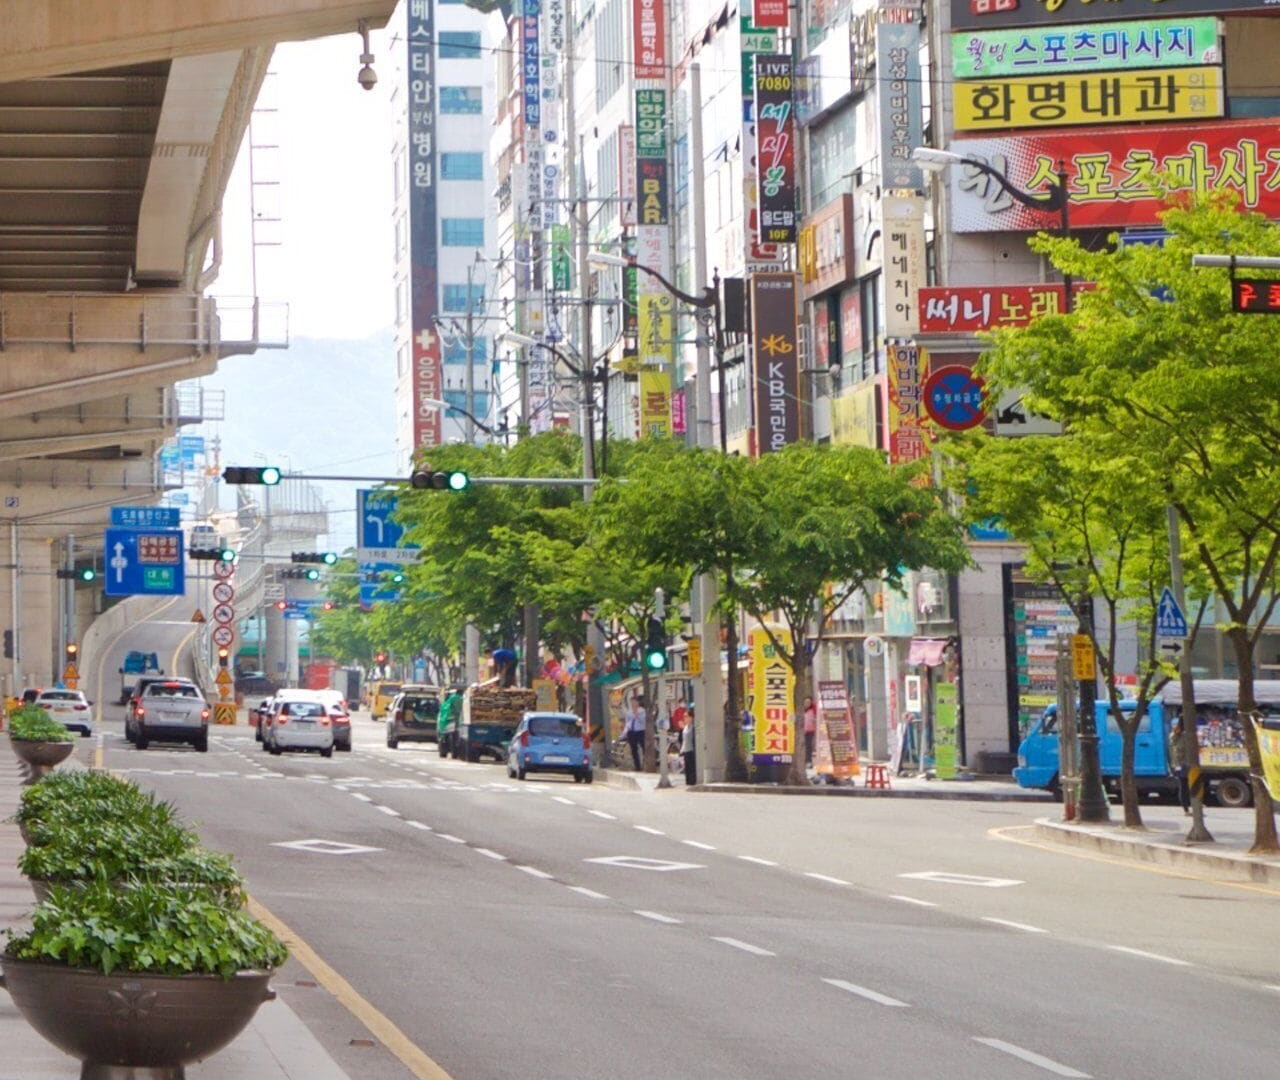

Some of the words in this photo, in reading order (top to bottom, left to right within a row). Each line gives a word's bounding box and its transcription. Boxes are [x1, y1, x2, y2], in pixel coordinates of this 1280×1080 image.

[744, 35, 775, 50] 서울
[1013, 25, 1195, 67] 스포츠마사지
[757, 63, 790, 76] LIVE
[757, 76, 791, 91] 7080
[888, 47, 912, 161] 삼성이비인후과
[971, 74, 1181, 123] 화명내과
[411, 129, 432, 188] 병원
[760, 101, 791, 197] 세시봉
[642, 178, 661, 224] BAR
[890, 231, 911, 321] 베네치아
[926, 292, 993, 326] 써니
[895, 349, 922, 420] 해바라기
[764, 661, 789, 754] 스포츠마사지
